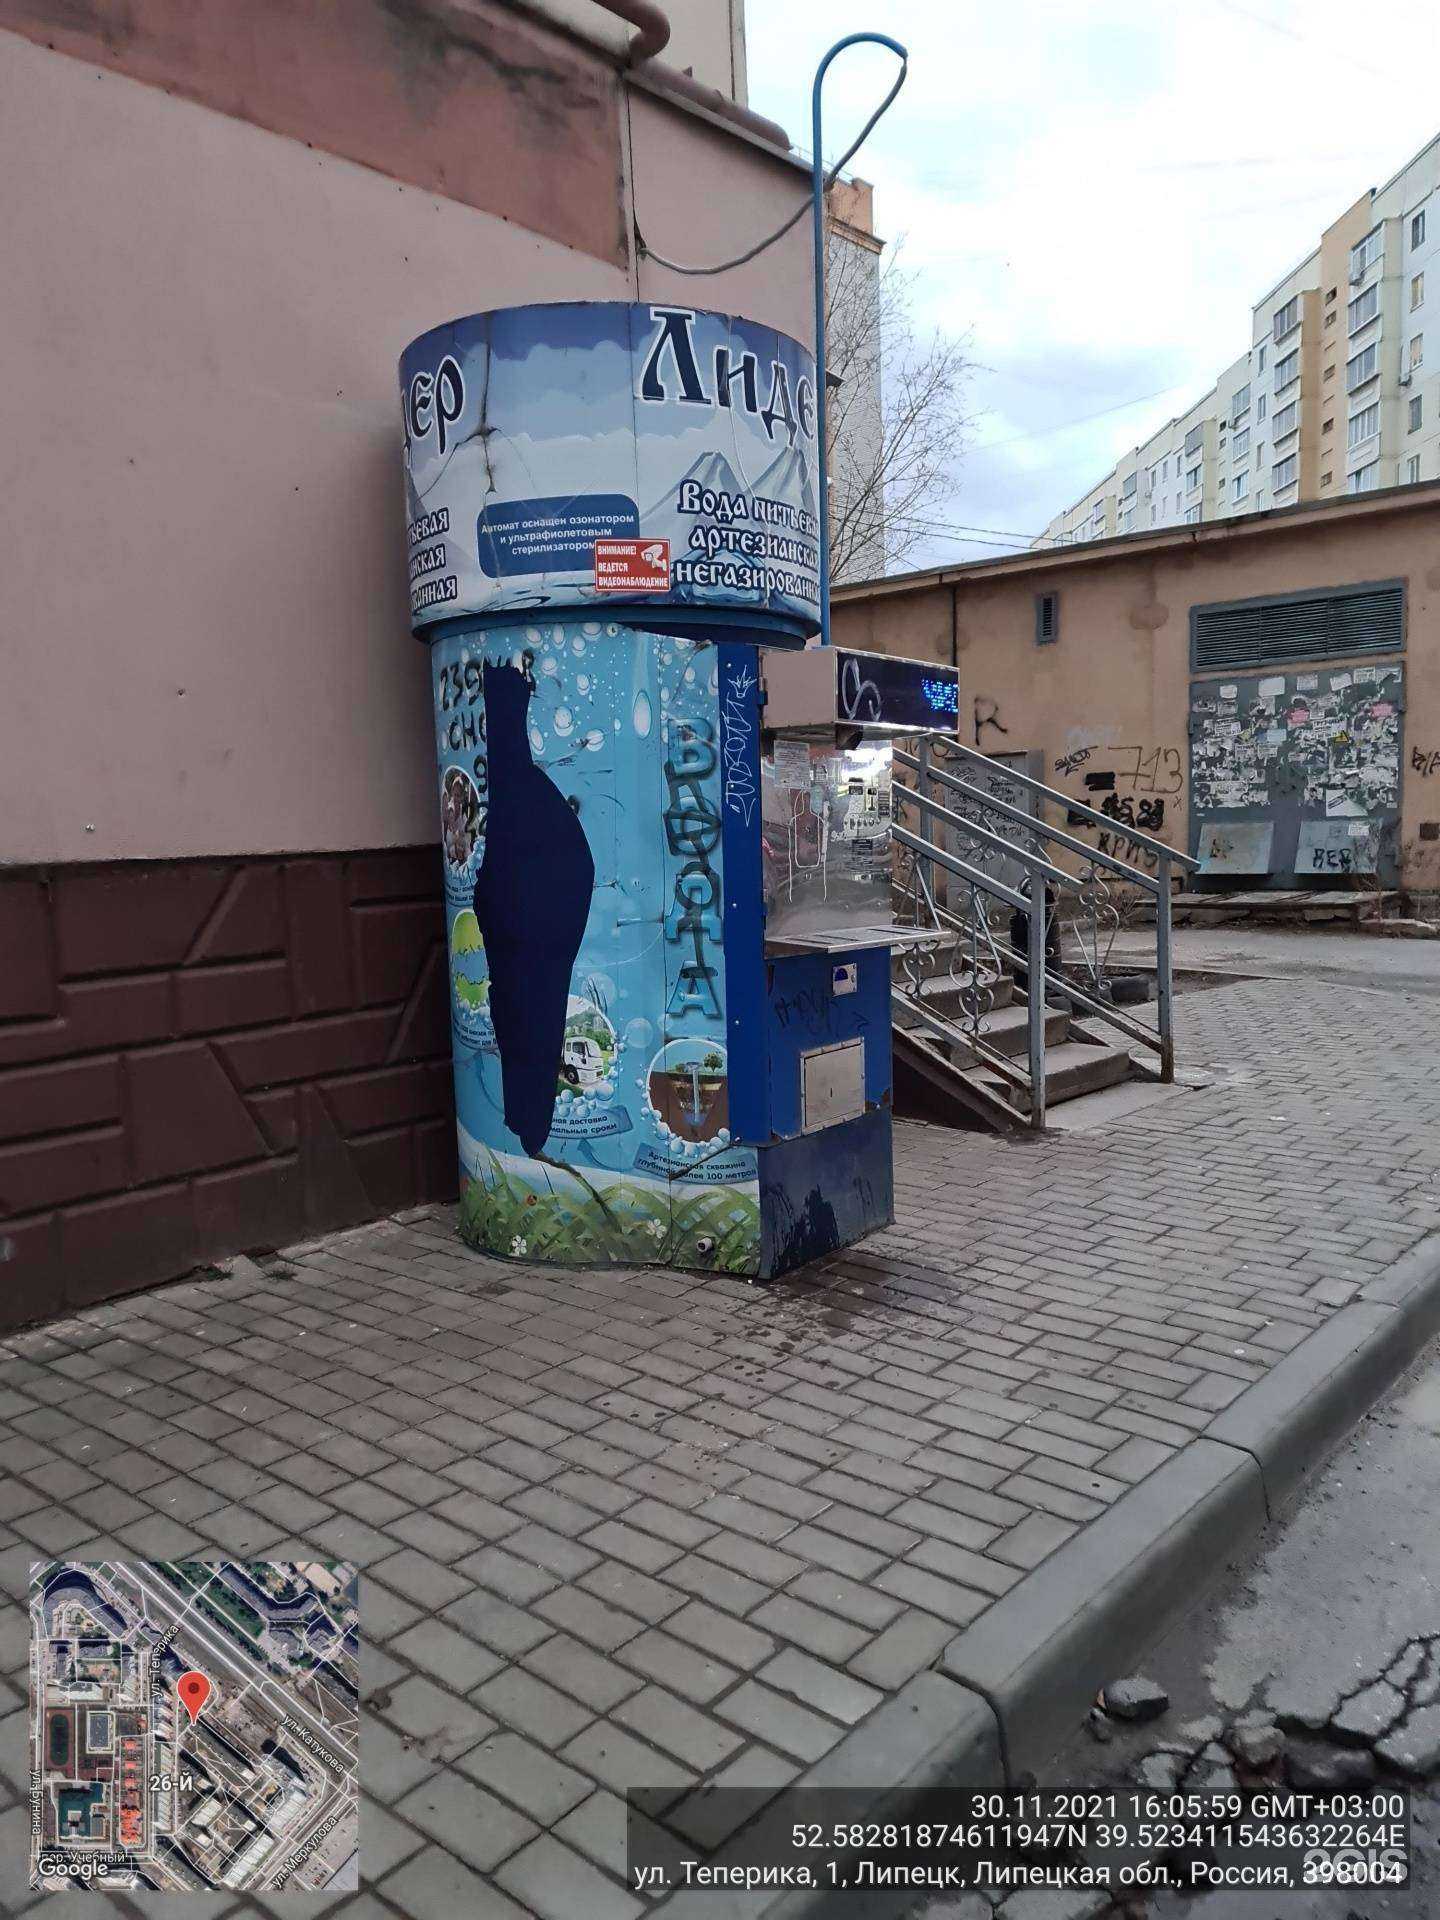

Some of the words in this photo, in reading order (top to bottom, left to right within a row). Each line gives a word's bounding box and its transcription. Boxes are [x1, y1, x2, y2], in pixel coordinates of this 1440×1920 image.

[677, 479, 749, 525] Вода
[481, 522, 520, 533] Автомат
[522, 517, 567, 529] оснащен
[569, 514, 635, 525] озонатором
[500, 536, 507, 544] и
[508, 528, 612, 544] ультрафиолетовым
[512, 542, 596, 556] стерилизатором
[597, 545, 637, 555] ВНИМАНИЕ!
[597, 563, 629, 573] ВЕДЕТСЯ
[598, 577, 669, 587] ВИДЕОНАБЛЮДЕНИЕ
[569, 1115, 608, 1125] доставка
[590, 1123, 617, 1135] сроки
[706, 1161, 746, 1170] скважина
[707, 1172, 723, 1180] 100
